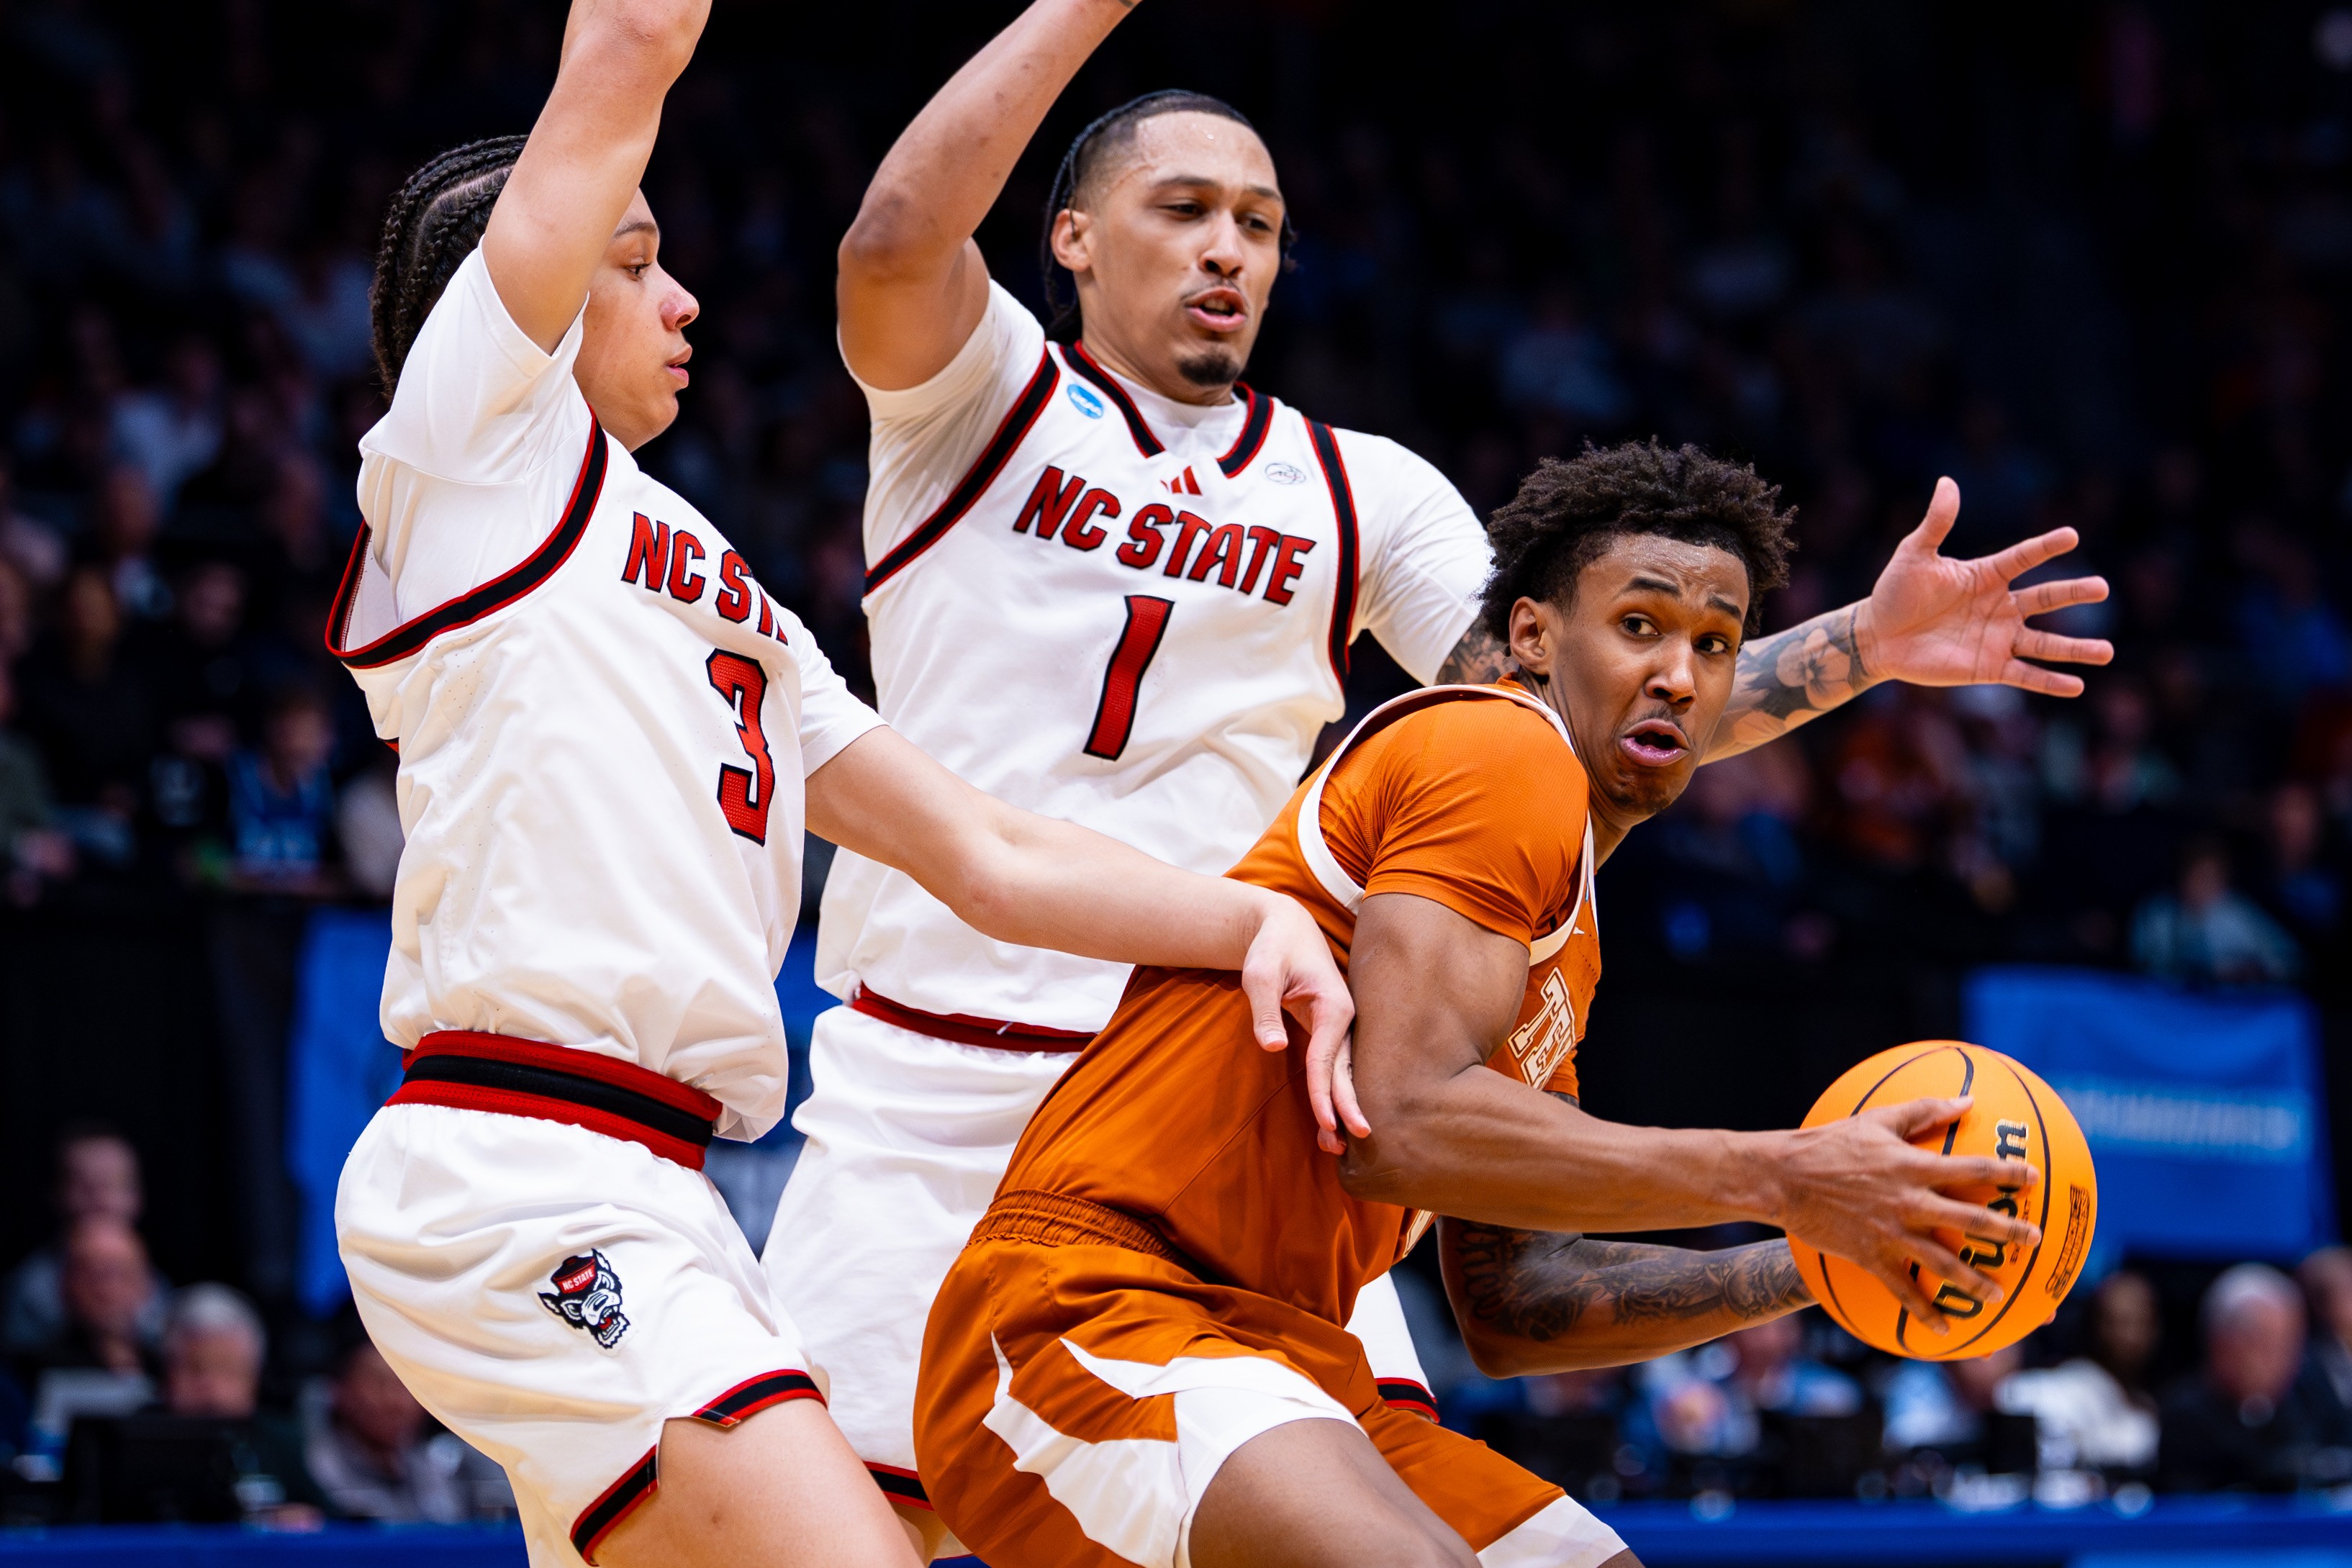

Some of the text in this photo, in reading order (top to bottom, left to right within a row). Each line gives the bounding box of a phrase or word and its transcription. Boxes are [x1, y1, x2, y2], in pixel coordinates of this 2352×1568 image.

[621, 511, 705, 604] NC
[1013, 465, 1317, 607] NC STATE
[705, 648, 775, 847] 3
[1082, 595, 1175, 761] 1
[562, 1269, 594, 1290] NC STATE
